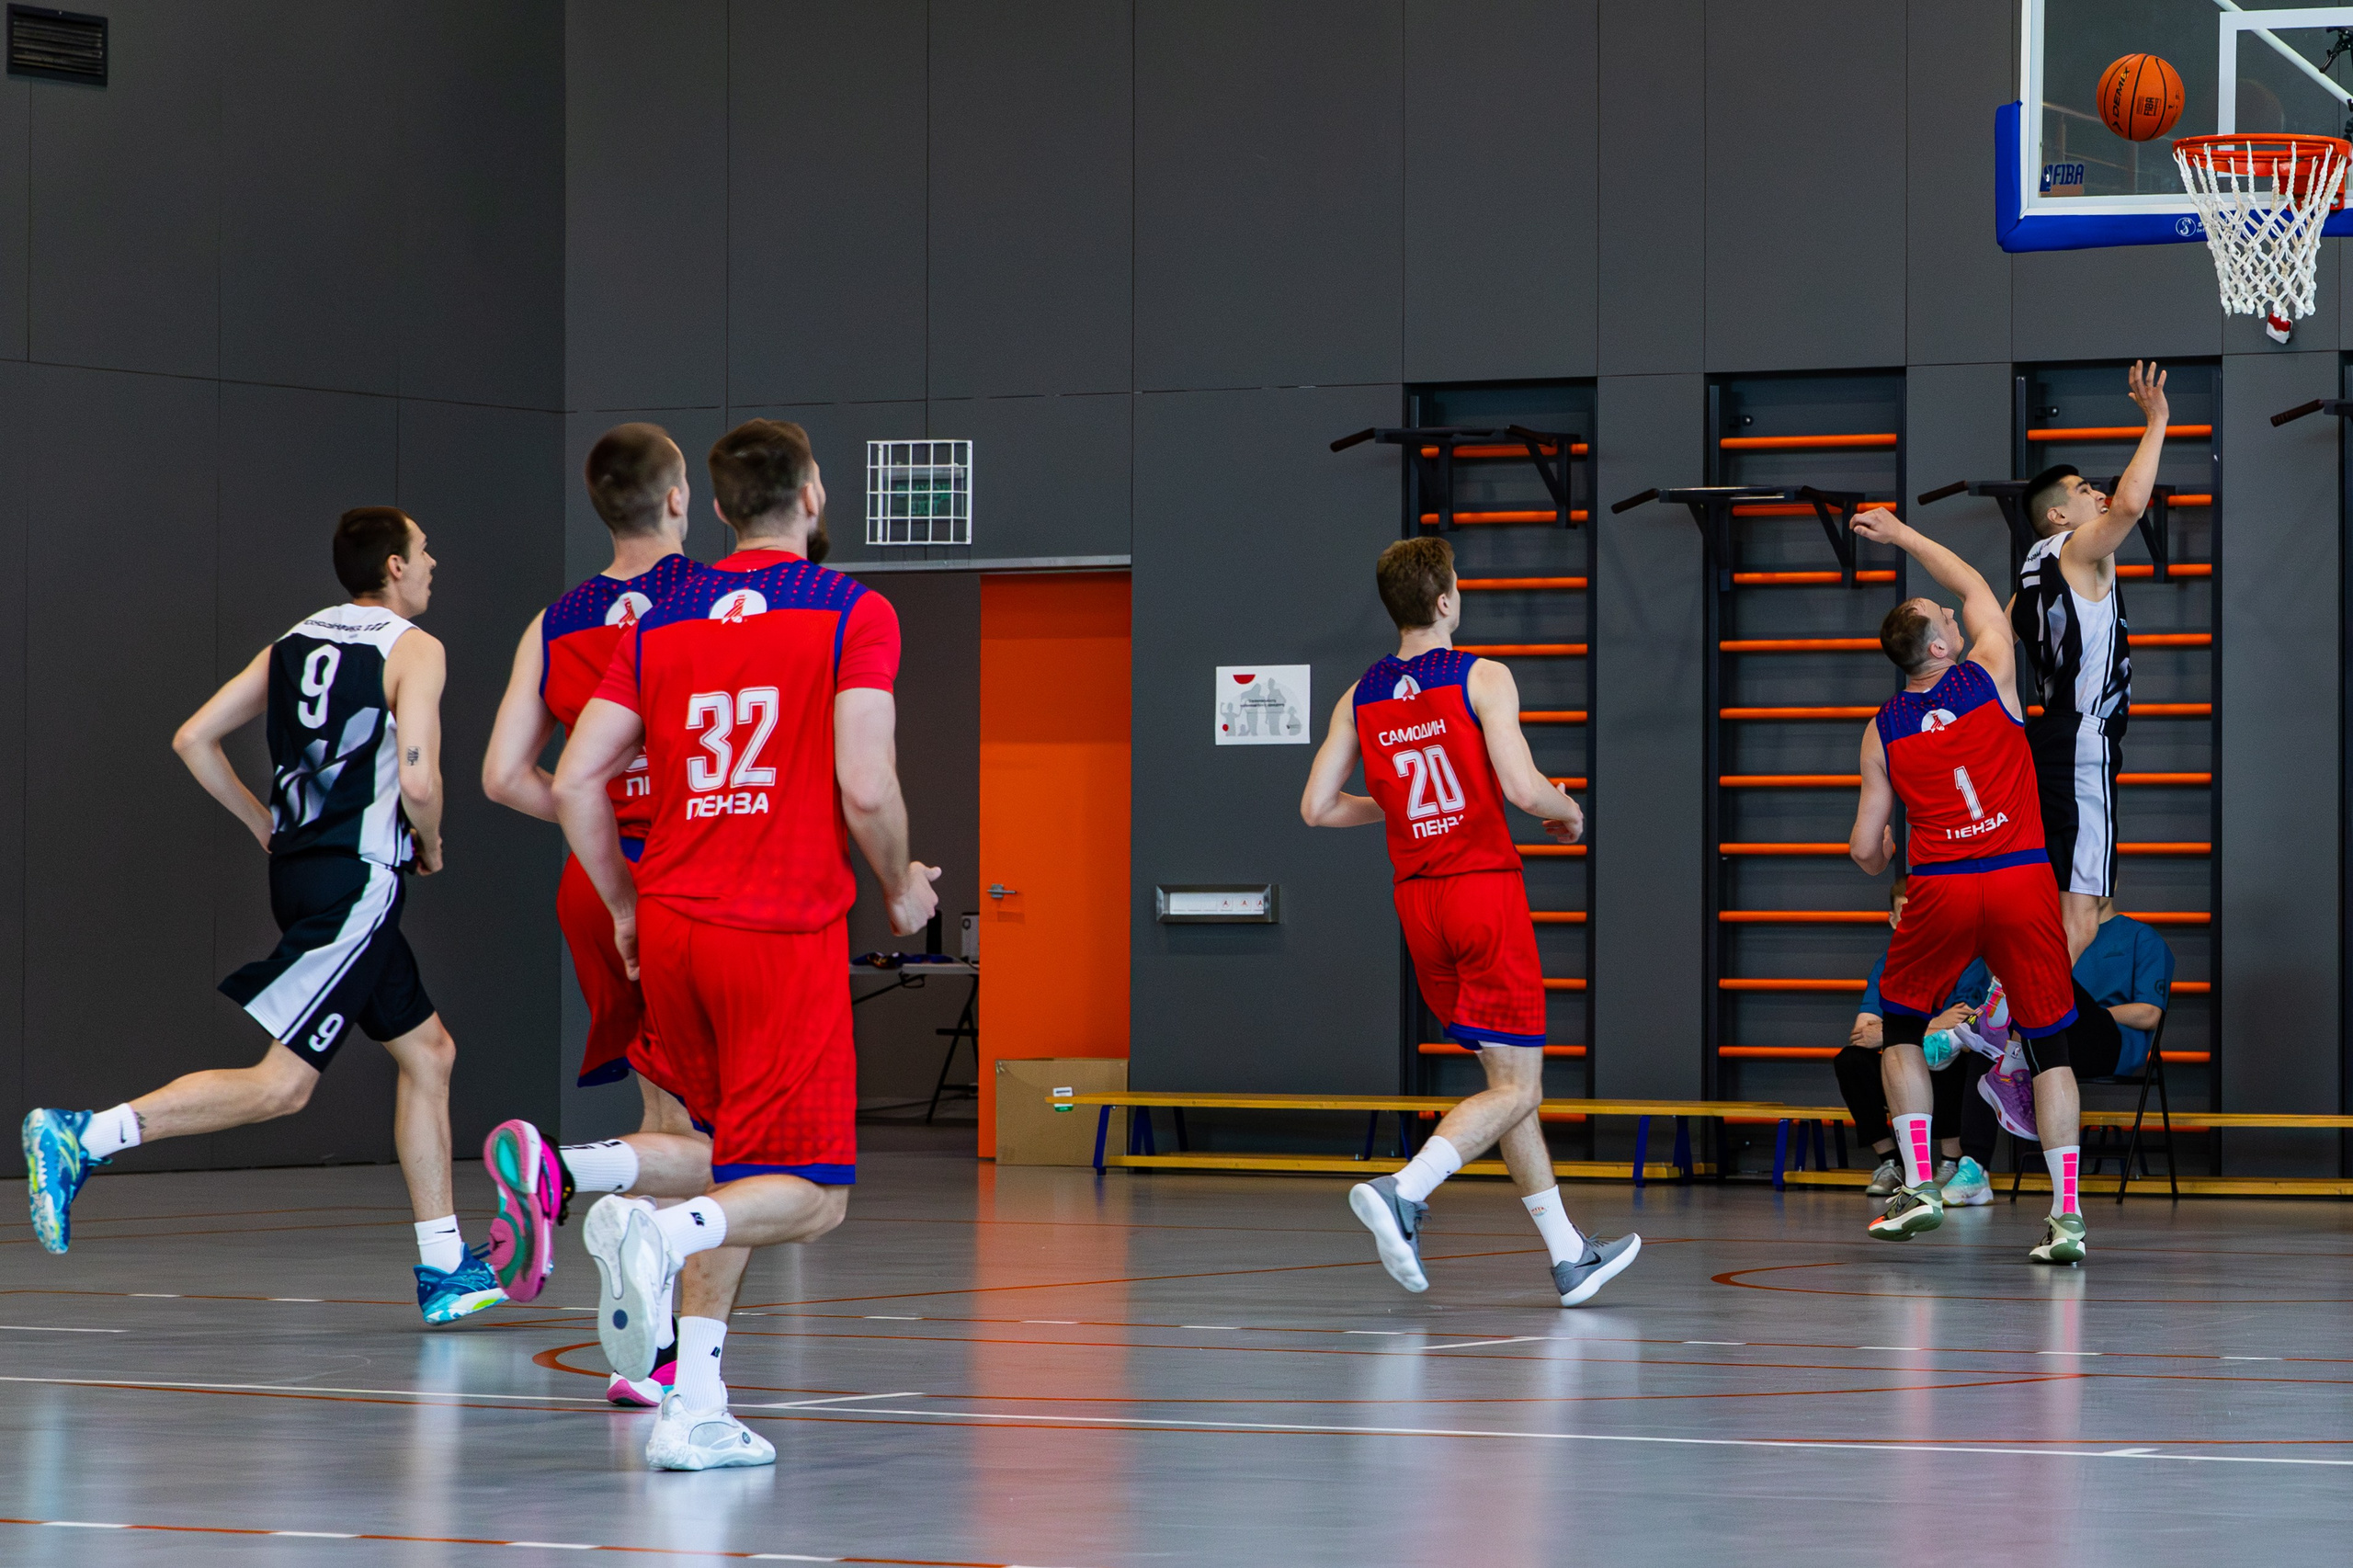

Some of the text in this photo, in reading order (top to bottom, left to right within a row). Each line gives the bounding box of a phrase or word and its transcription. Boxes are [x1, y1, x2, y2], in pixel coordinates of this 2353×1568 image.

[2112, 67, 2130, 119] DEMIX
[2143, 97, 2155, 117] FIBA
[2053, 164, 2084, 185] FIBA
[298, 644, 341, 729] 9
[686, 686, 779, 792] 32
[1379, 719, 1447, 746] САМОДИН
[1392, 744, 1466, 821] 20
[1953, 766, 1984, 821] 1
[687, 792, 768, 820] ПЕНЗА
[309, 1013, 345, 1052] 9
